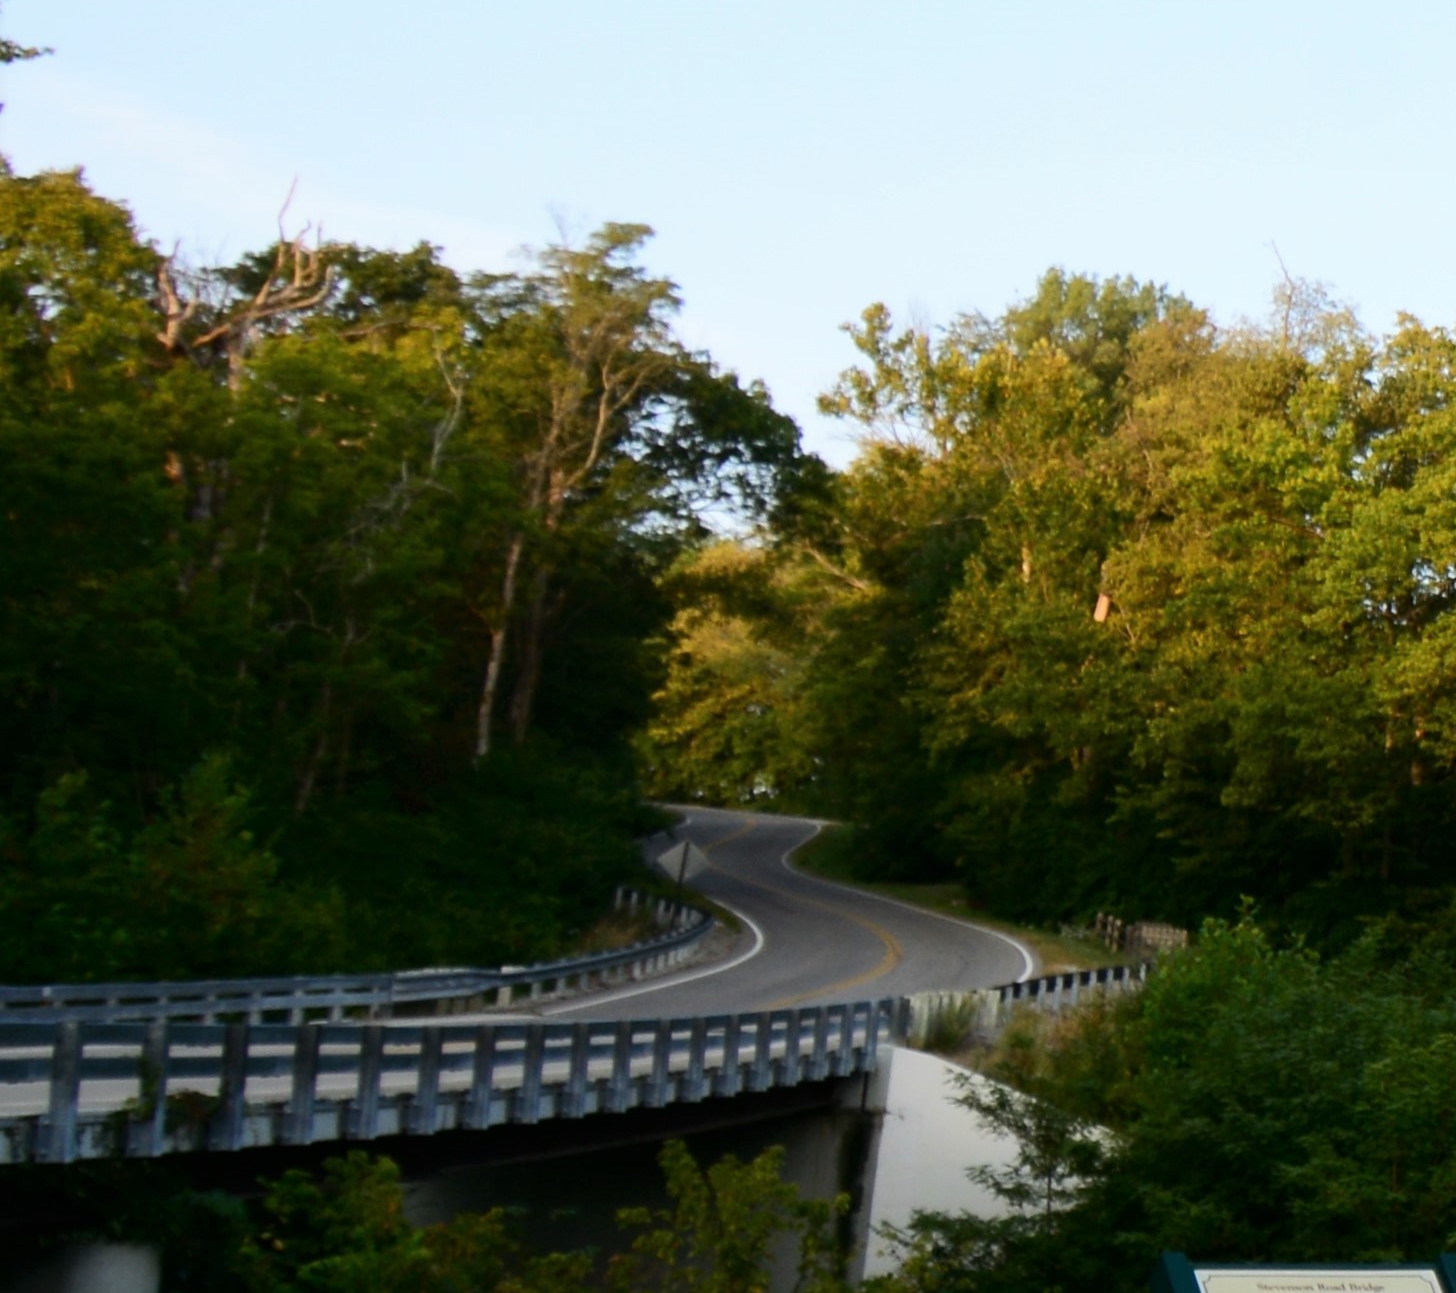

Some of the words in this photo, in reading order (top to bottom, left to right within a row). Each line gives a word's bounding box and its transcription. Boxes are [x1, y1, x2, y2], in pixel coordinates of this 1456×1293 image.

[1256, 1283, 1314, 1292] Stevenson
[1317, 1283, 1346, 1292] Road
[1349, 1283, 1384, 1293] Bridge
